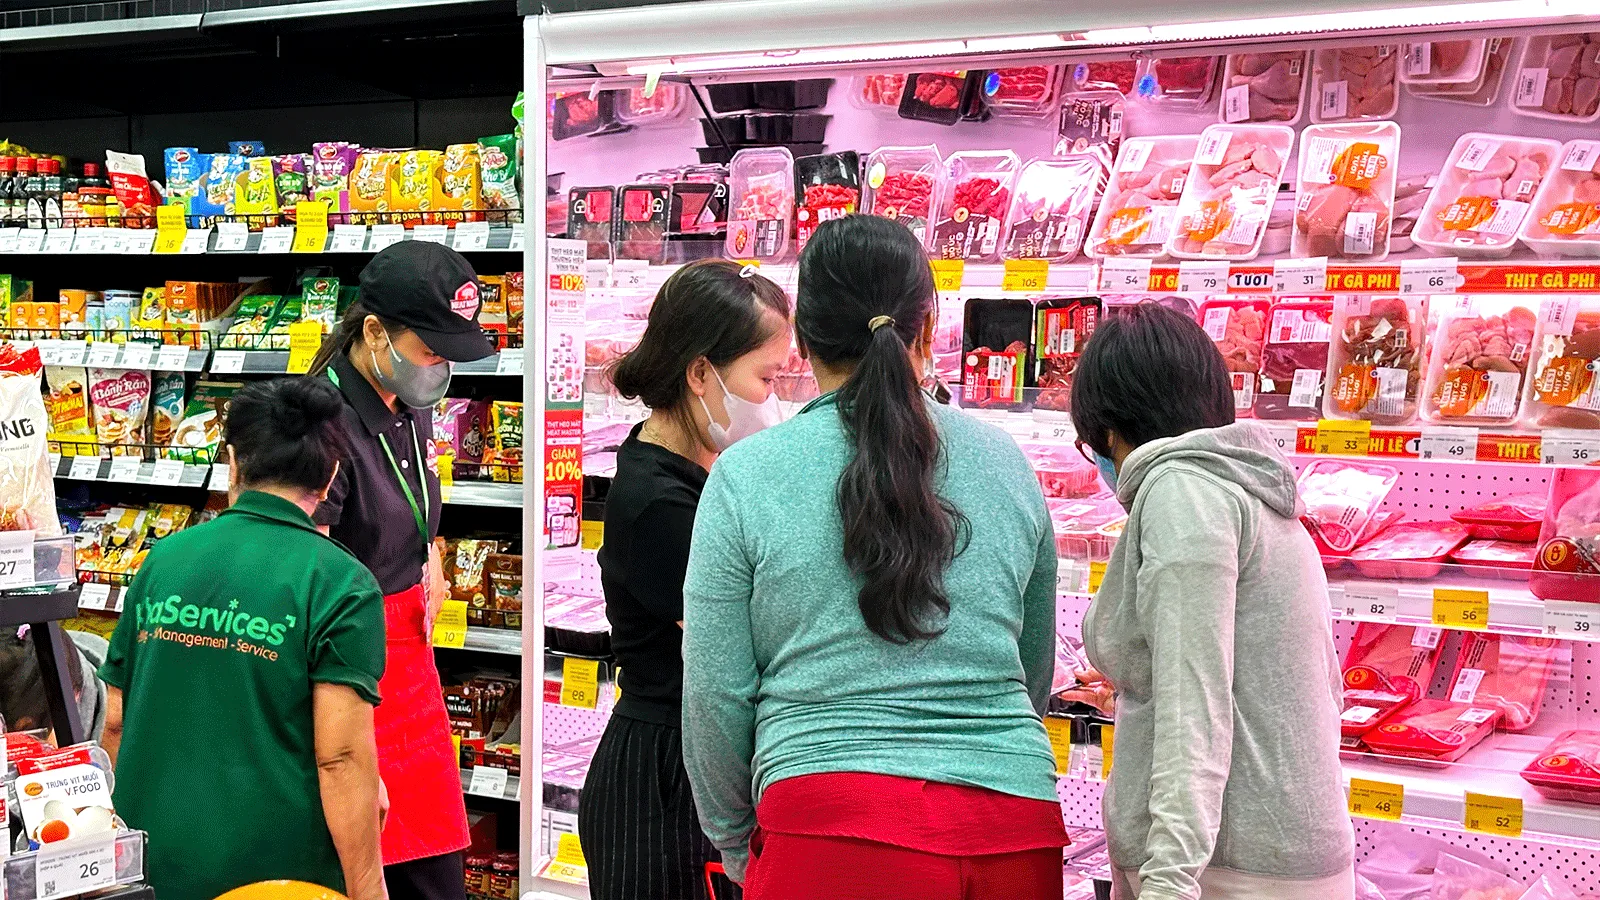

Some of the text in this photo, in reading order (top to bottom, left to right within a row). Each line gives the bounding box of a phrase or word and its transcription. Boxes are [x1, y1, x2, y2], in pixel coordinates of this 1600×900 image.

[166, 240, 174, 248] 16
[305, 238, 315, 246] 16
[560, 274, 585, 292] 10%
[630, 276, 640, 284] 26
[942, 278, 953, 286] 79
[1022, 278, 1037, 287] 105
[1125, 276, 1138, 284] 54
[1204, 278, 1216, 288] 79
[1303, 276, 1314, 284] 31
[1367, 274, 1392, 288] PHI
[1428, 276, 1444, 286] 66
[1568, 274, 1596, 288] PHI
[965, 372, 975, 399] BEEF
[0, 418, 36, 440] NG
[1054, 428, 1066, 438] 97
[1344, 440, 1358, 450] 33
[1449, 446, 1464, 456] 49
[1572, 449, 1588, 459] 36
[546, 461, 582, 481] 10%
[0, 561, 16, 576] 27
[1370, 604, 1384, 614] 82
[1462, 610, 1477, 620] 56
[1574, 622, 1590, 632] 39
[444, 632, 455, 642] 10
[237, 638, 279, 662] Service
[64, 782, 101, 796] V.FOOD
[1376, 802, 1390, 812] 48
[1496, 817, 1510, 828] 52
[80, 861, 99, 878] 26
